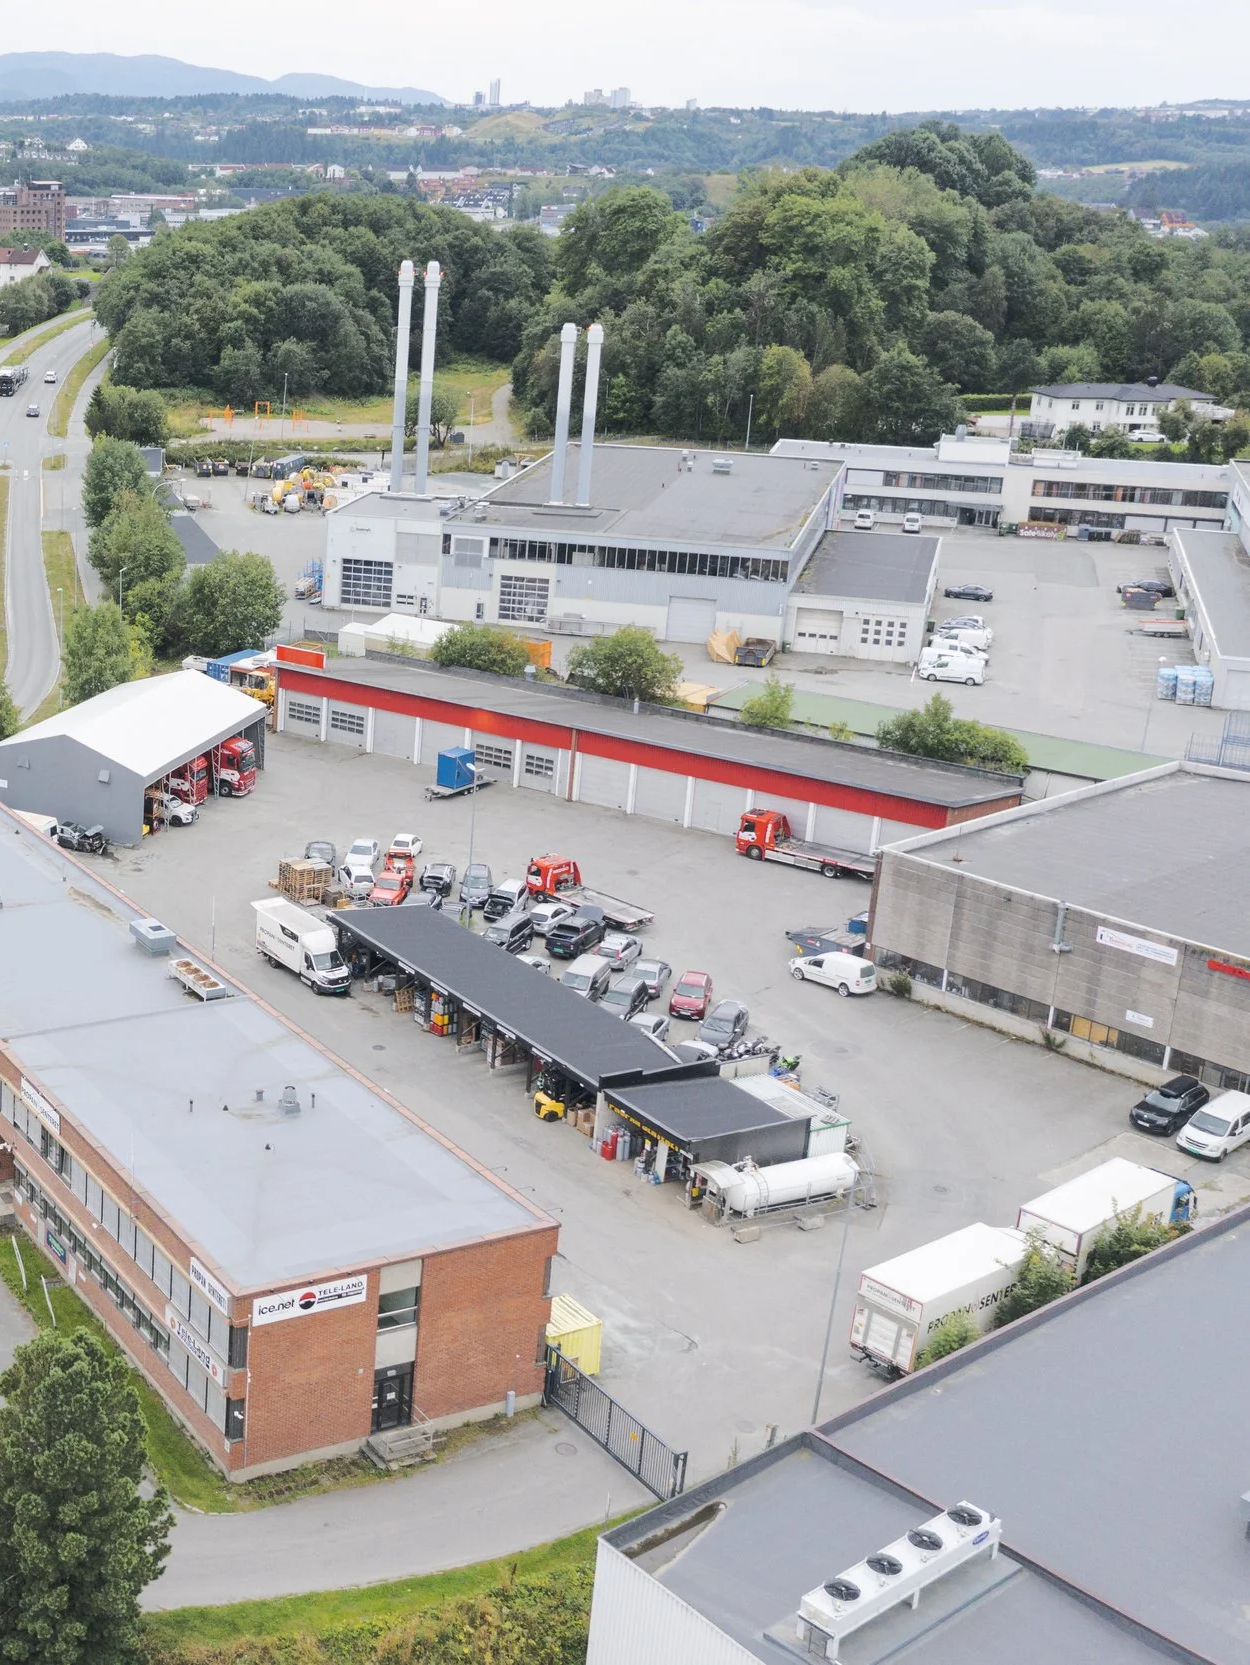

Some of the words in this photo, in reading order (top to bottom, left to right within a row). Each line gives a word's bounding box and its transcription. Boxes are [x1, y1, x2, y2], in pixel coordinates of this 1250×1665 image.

[191, 1264, 206, 1289] PROPAN
[318, 1281, 363, 1297] TELE-LAND
[866, 1284, 888, 1298] PROPAN
[258, 1299, 295, 1316] ice.net
